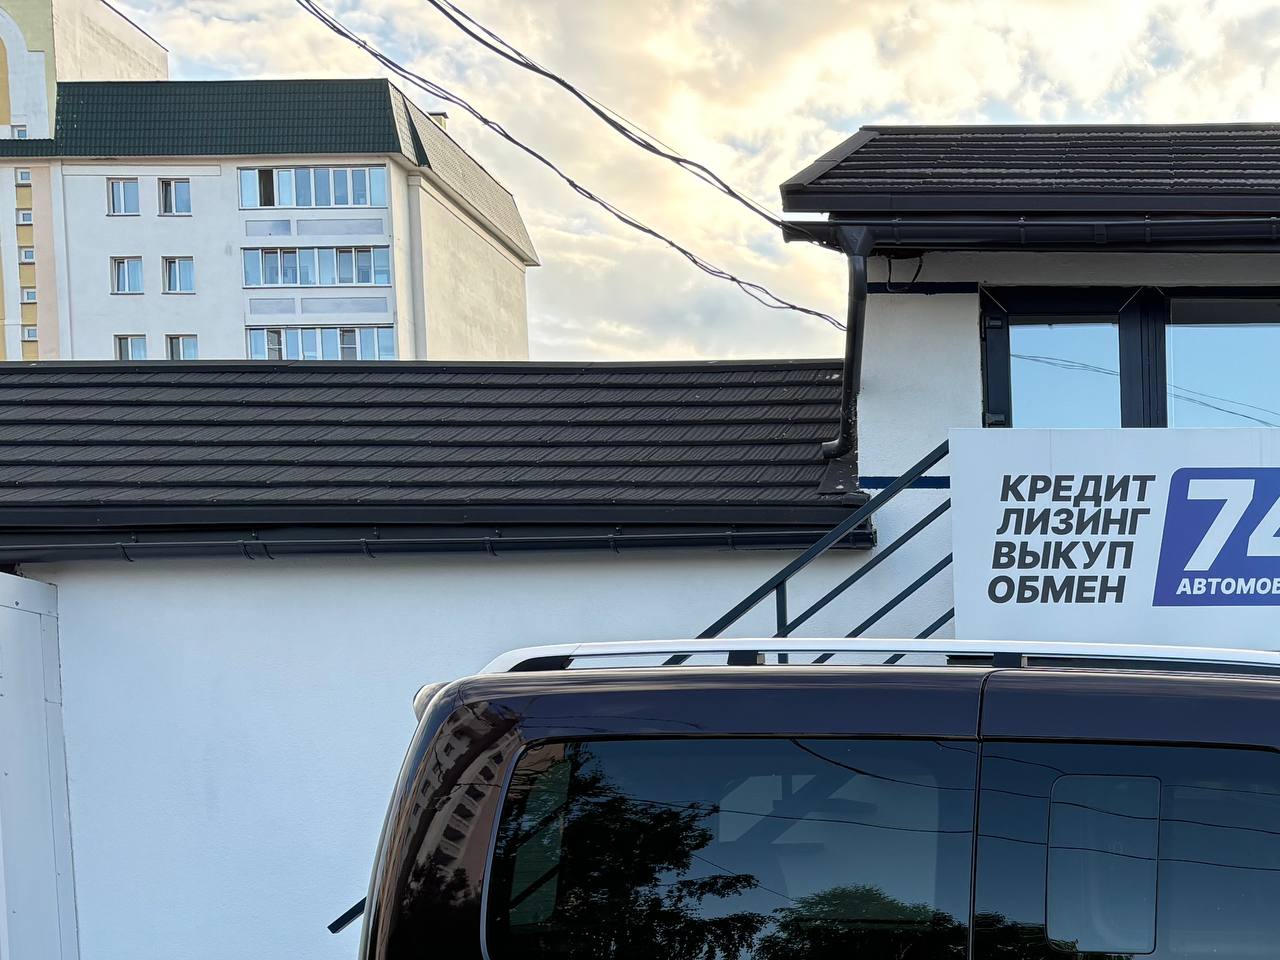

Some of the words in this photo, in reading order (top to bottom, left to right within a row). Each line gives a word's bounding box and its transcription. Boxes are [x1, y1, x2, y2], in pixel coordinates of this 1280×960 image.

[1000, 474, 1156, 508] КРЕДИТ
[996, 508, 1151, 535] ЛИЗИНГ
[992, 541, 1134, 569] ВЫКУП
[987, 575, 1126, 604] ОБМЕН
